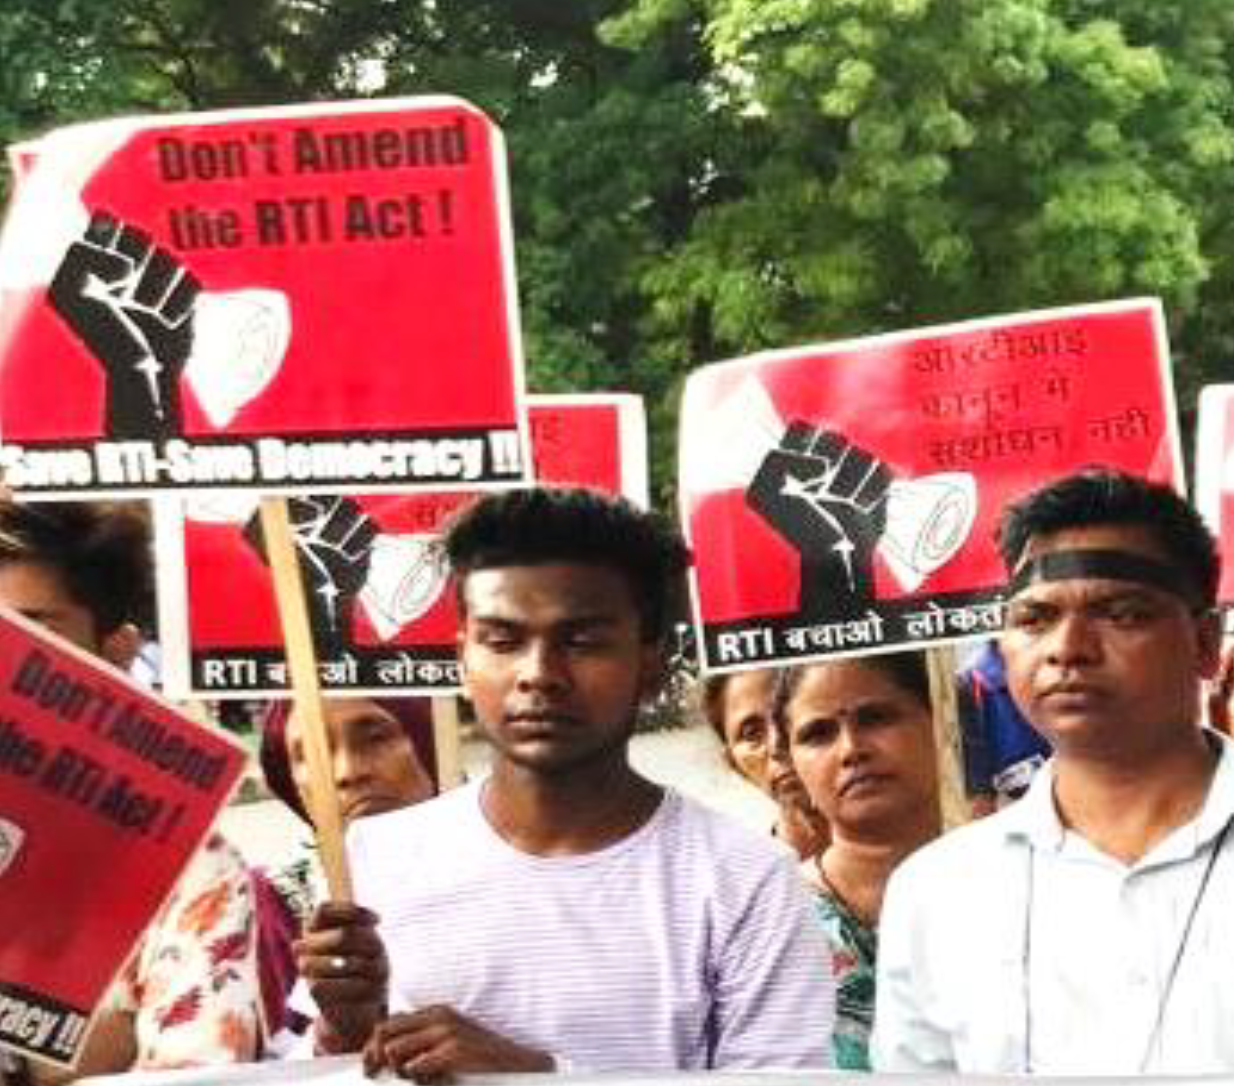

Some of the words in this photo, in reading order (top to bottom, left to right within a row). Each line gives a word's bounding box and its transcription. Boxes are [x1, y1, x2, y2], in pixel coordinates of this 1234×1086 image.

[157, 131, 279, 182] Don't
[290, 117, 469, 174] Amend
[168, 204, 242, 252] the
[255, 195, 333, 246] RTI
[345, 192, 424, 242] Act
[256, 436, 483, 480] Democracy
[717, 627, 774, 662] RTI
[784, 610, 884, 652] बचाओ
[903, 595, 1005, 638] लोकतं
[204, 660, 257, 687] RTI
